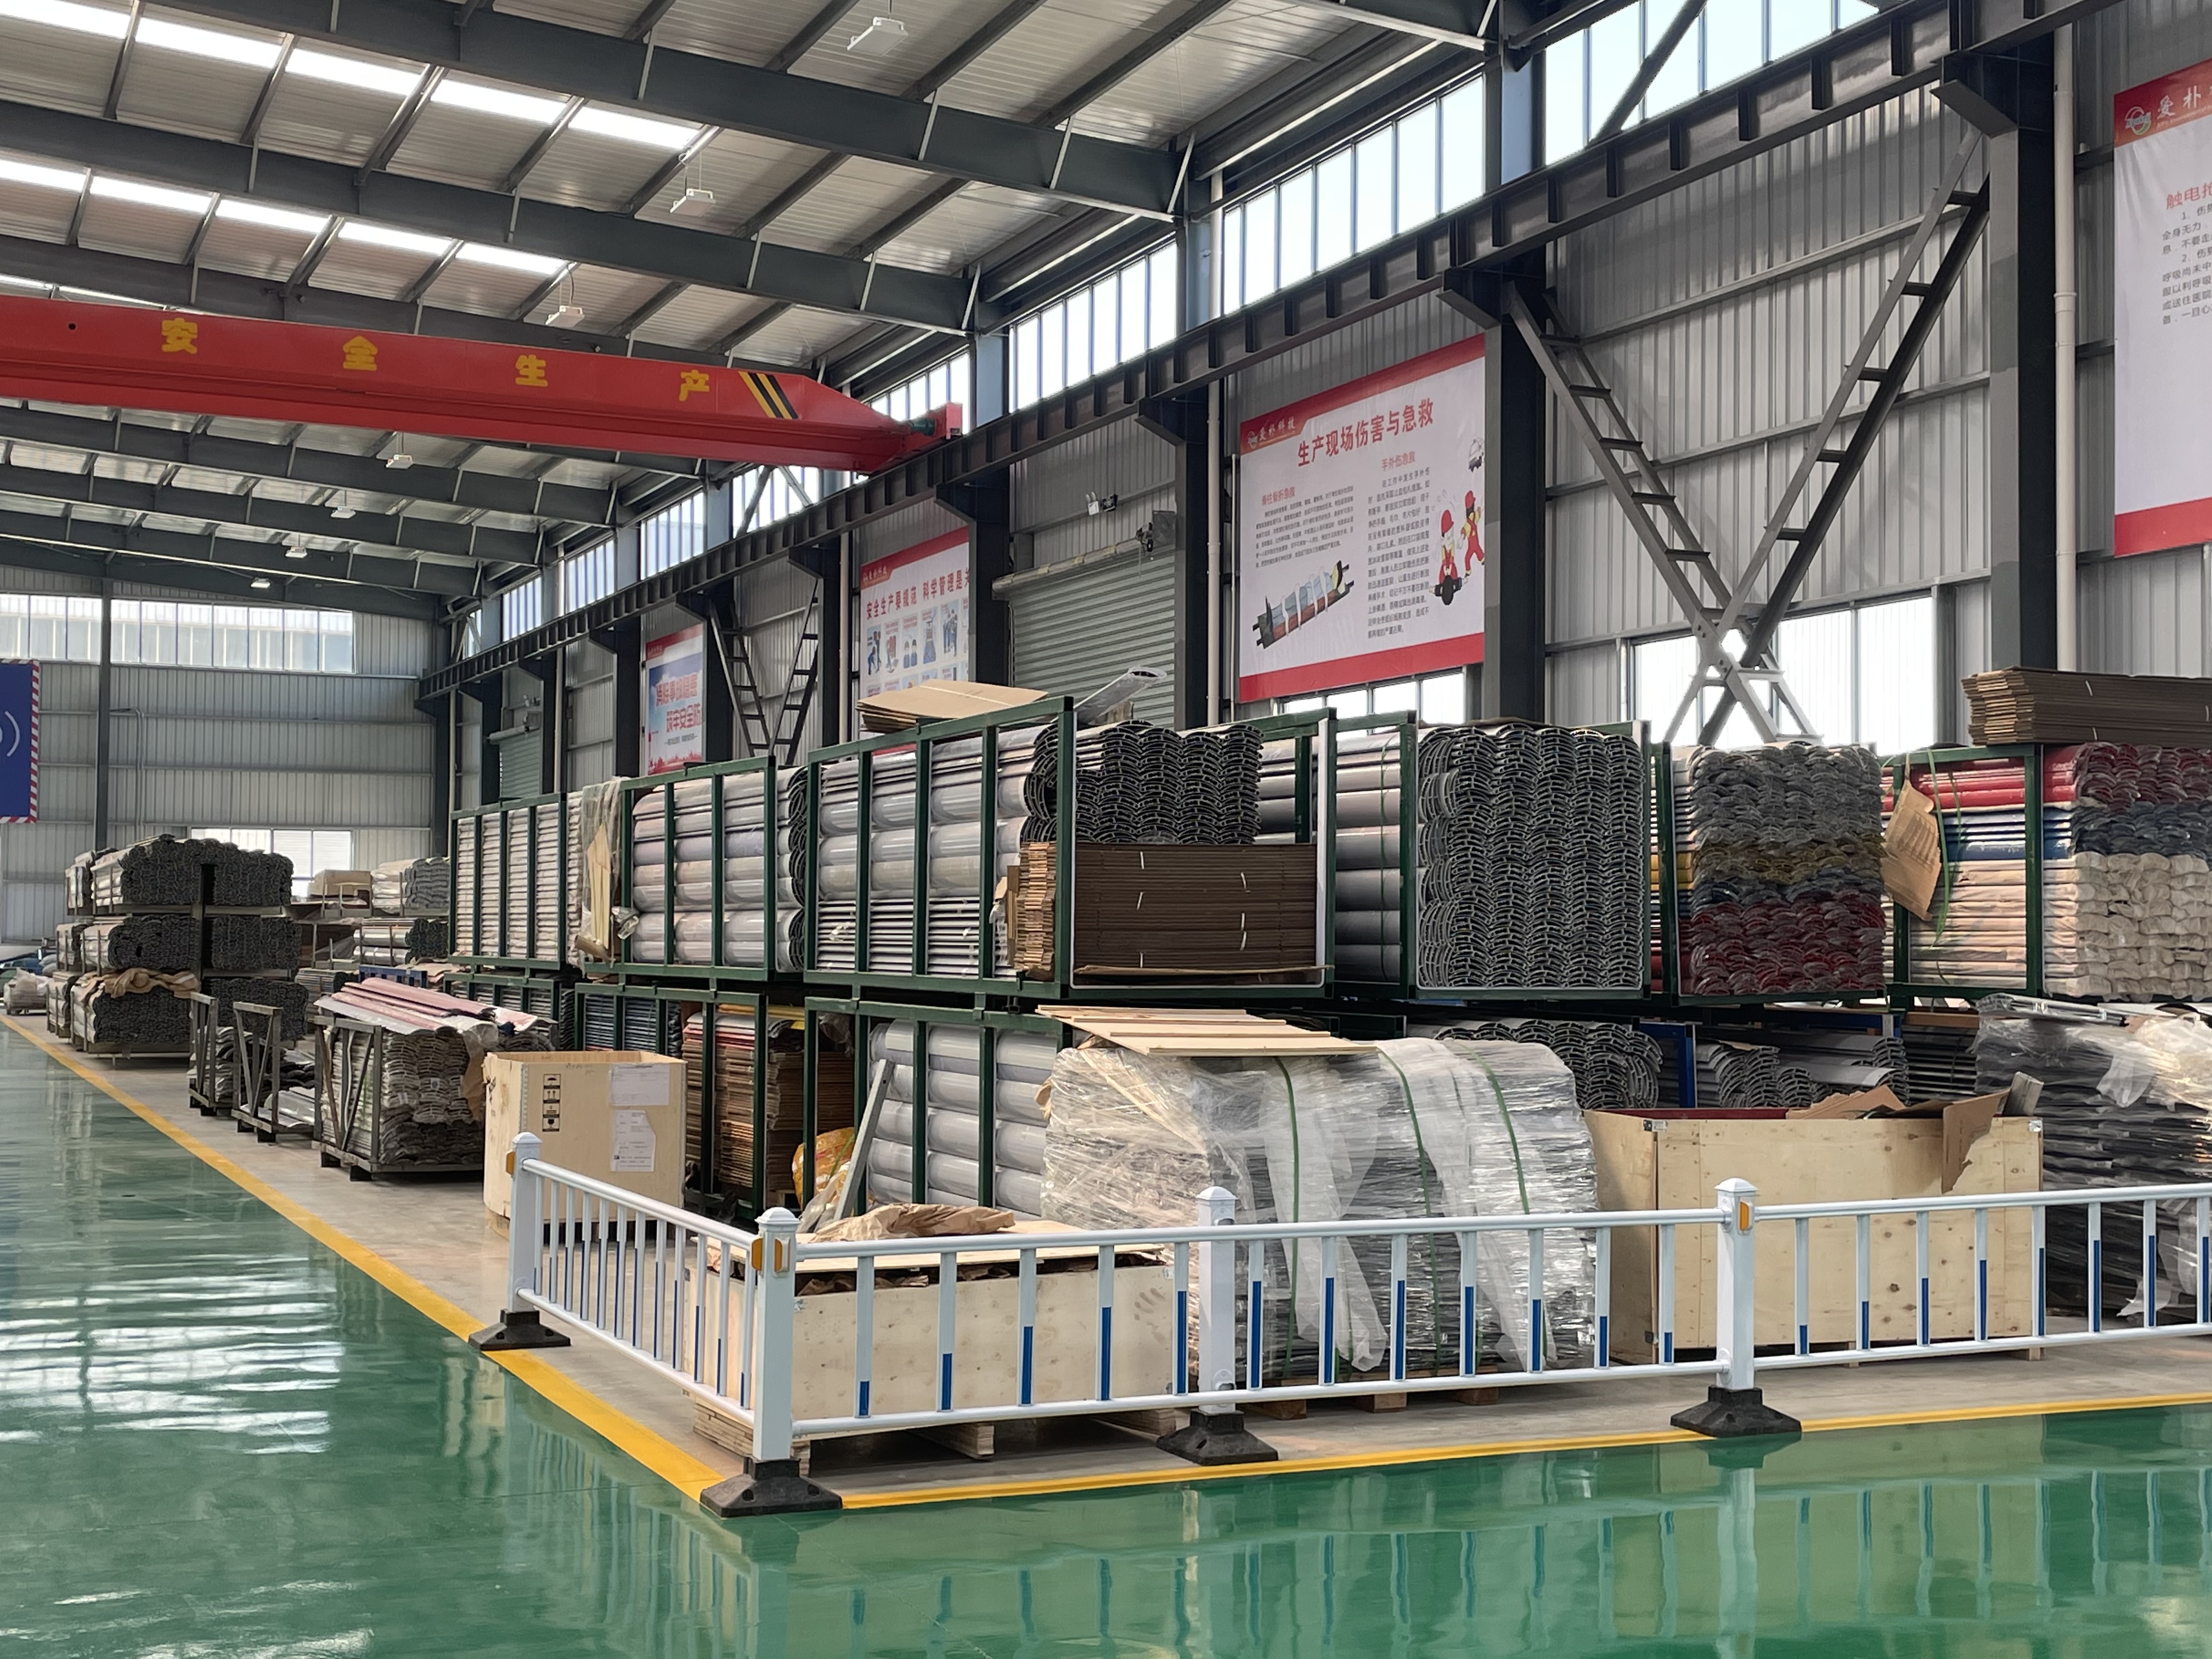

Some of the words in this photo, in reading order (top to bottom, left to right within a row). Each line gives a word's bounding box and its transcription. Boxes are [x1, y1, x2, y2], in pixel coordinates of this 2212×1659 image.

[2157, 85, 2212, 120] 爱朴
[161, 317, 710, 402] 安全生产
[1297, 398, 1433, 467] 生产现场伤害与急救
[866, 586, 917, 620] 安全生产要规范
